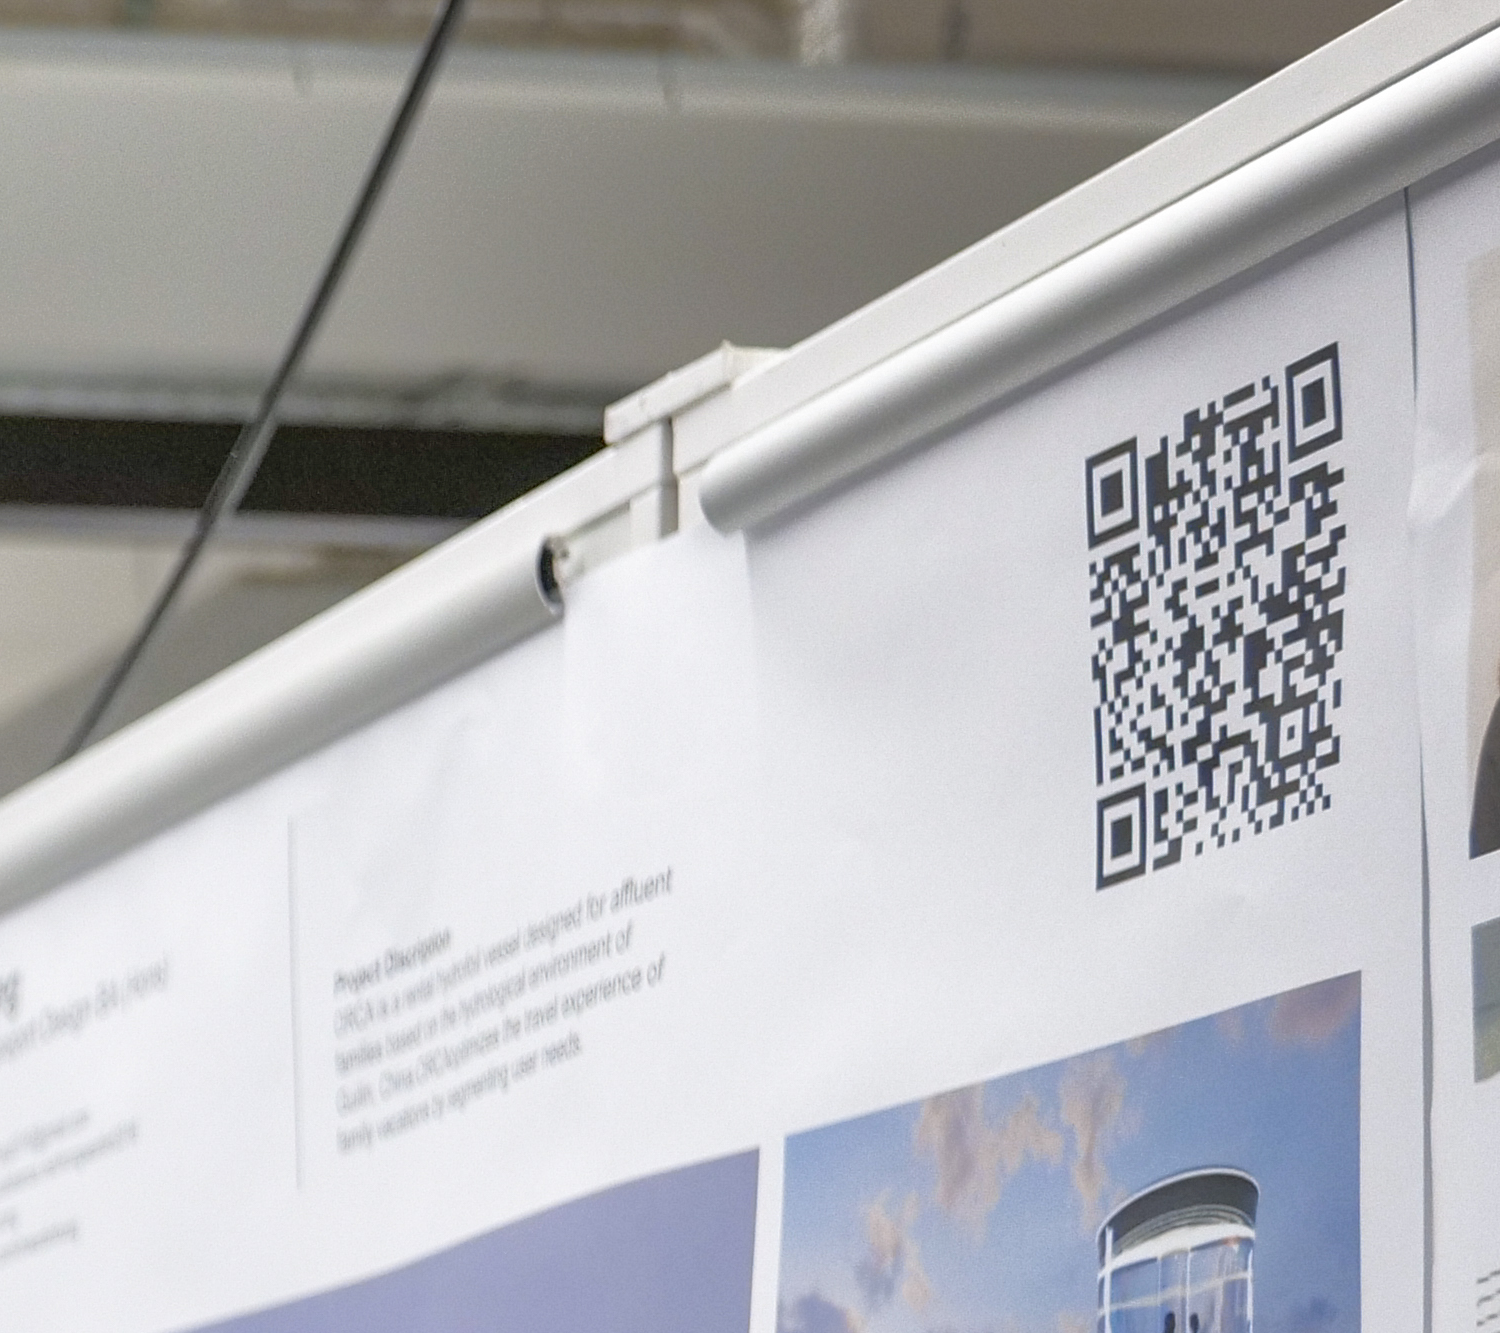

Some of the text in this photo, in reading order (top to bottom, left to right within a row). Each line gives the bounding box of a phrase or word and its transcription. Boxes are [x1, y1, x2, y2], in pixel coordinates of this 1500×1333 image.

[524, 899, 581, 950] designed
[587, 892, 605, 922] for
[610, 866, 672, 912] affluent
[528, 932, 610, 989] environment
[616, 920, 632, 953] of
[562, 966, 641, 1019] experience
[647, 952, 665, 987] of
